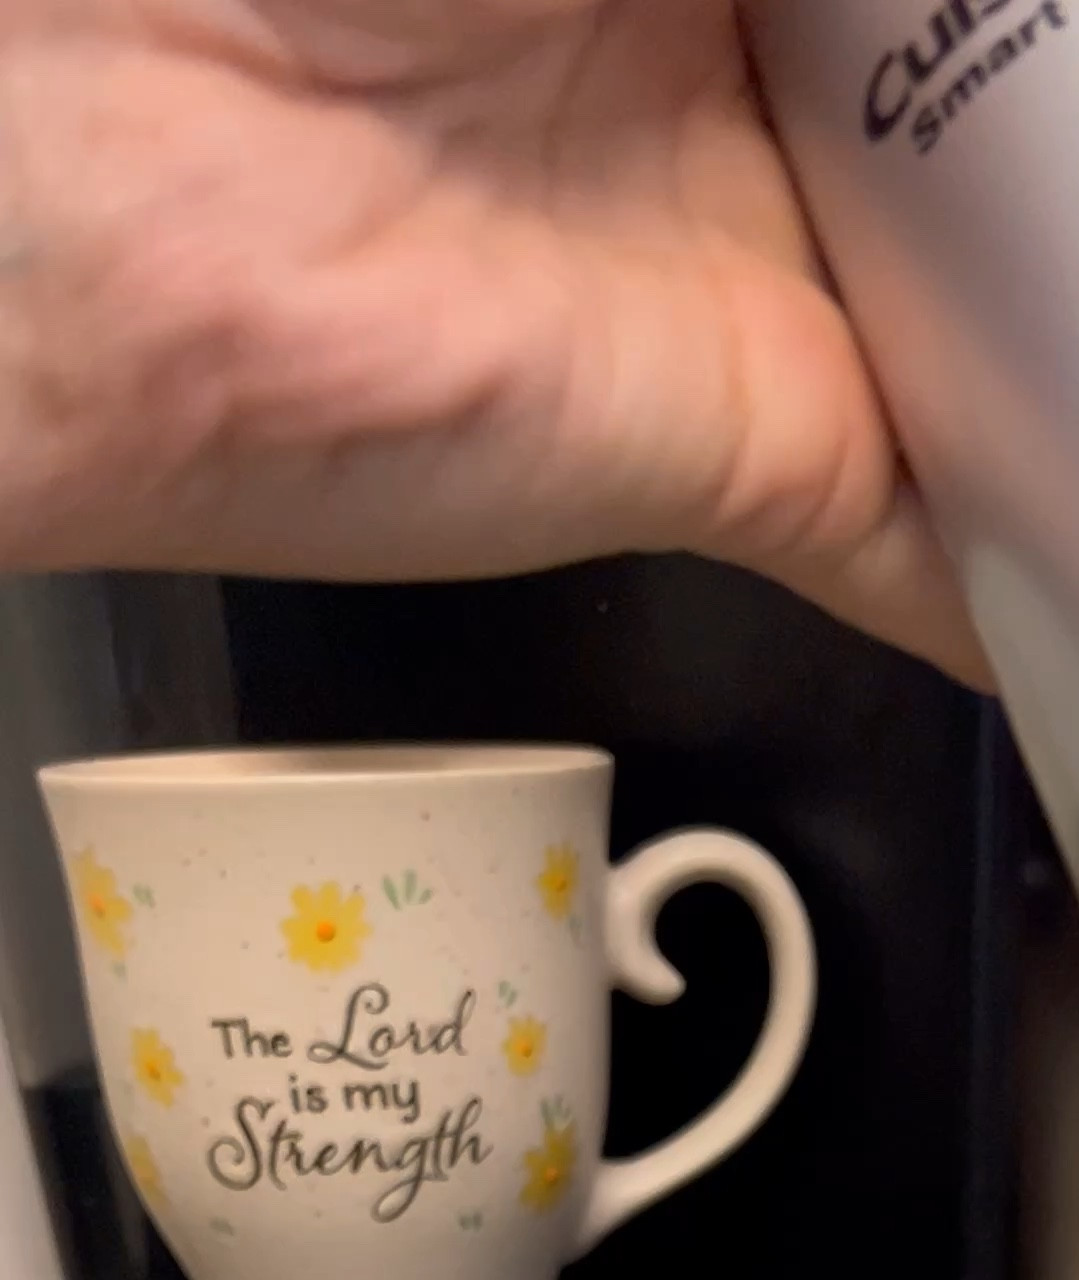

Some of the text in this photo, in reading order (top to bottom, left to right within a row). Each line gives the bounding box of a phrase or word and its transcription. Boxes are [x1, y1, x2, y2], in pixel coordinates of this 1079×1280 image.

[210, 981, 477, 1071] The Lord
[288, 1073, 420, 1124] is my
[206, 1095, 494, 1224] Strength
